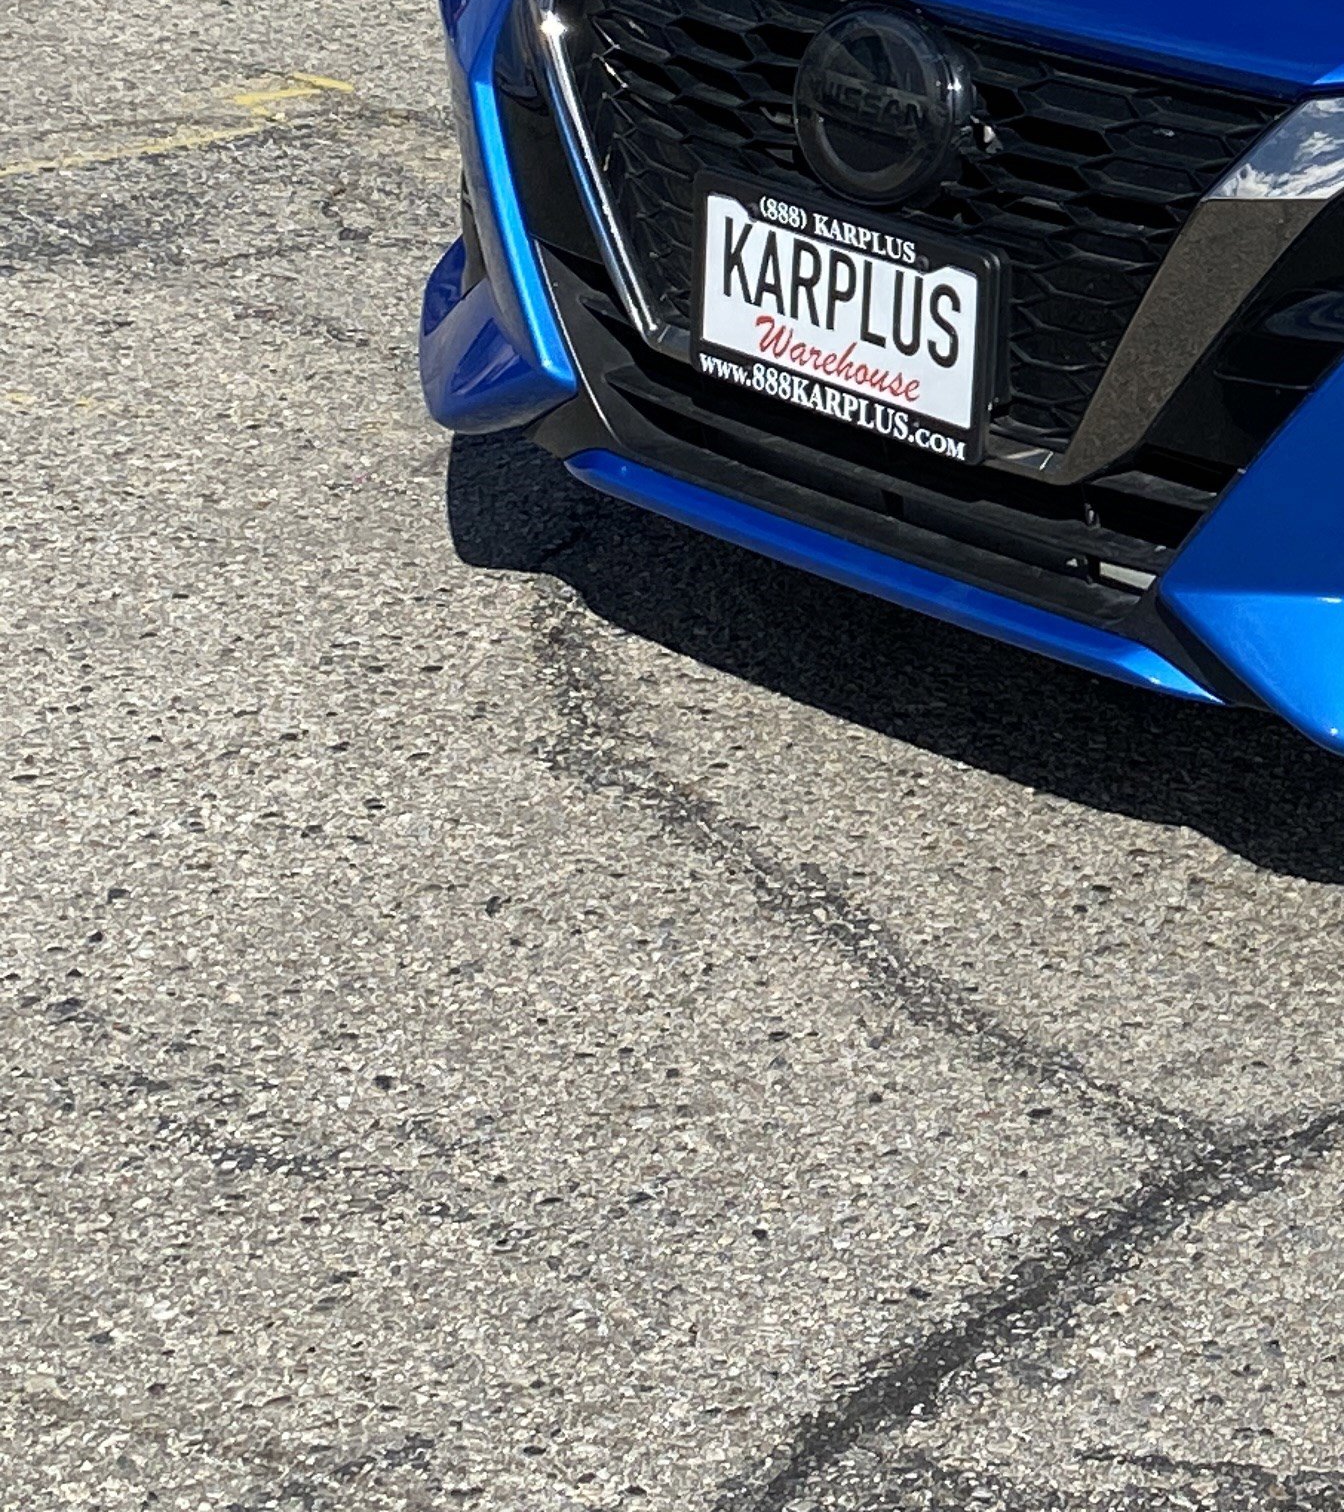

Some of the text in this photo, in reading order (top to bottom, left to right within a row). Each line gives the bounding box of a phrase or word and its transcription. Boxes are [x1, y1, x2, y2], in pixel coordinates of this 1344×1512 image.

[759, 195, 916, 264] (888) KARPLUS
[722, 216, 961, 369] KARPLUS
[755, 315, 921, 402] Warehouse
